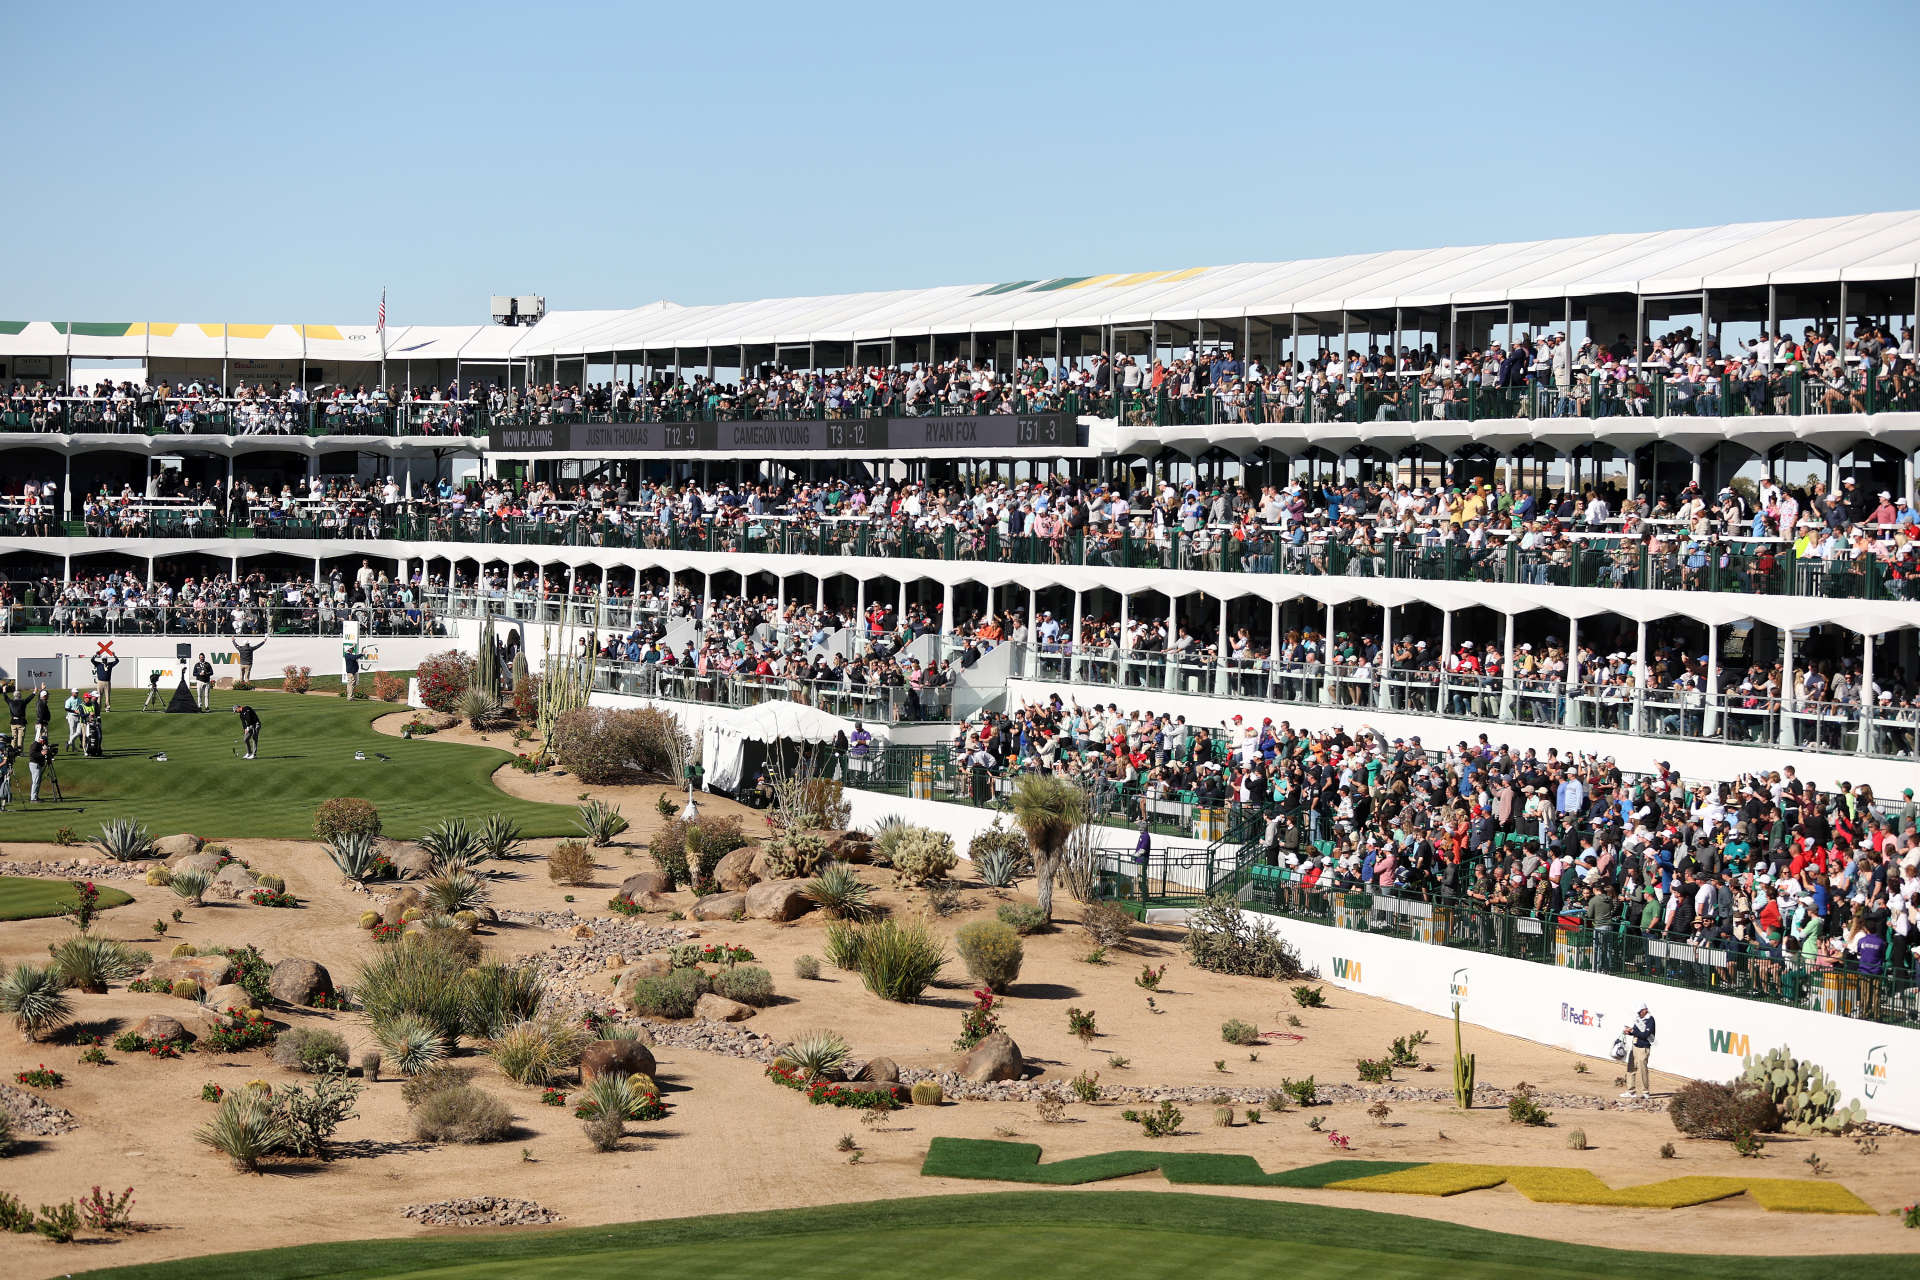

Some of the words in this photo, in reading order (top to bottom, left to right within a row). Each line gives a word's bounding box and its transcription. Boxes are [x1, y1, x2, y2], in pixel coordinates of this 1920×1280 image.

[502, 431, 519, 447] NOW
[521, 430, 553, 447] PLAYING
[586, 429, 613, 446] JUSTIN
[614, 428, 649, 446] THOMAS
[665, 427, 681, 446] T12
[686, 427, 695, 445] -9
[733, 426, 777, 445] CAMERON
[778, 426, 810, 444] YOUNG
[830, 425, 843, 444] T3
[849, 425, 865, 444] -12
[926, 422, 954, 442] RYAN
[955, 421, 977, 442] FOX
[1018, 420, 1039, 441] T51
[1045, 420, 1056, 441] -3
[1332, 956, 1362, 983] WM
[1450, 983, 1468, 997] WM
[1569, 1007, 1594, 1027] FedEx
[1709, 1028, 1751, 1056] WM
[1864, 1062, 1887, 1079] WM
